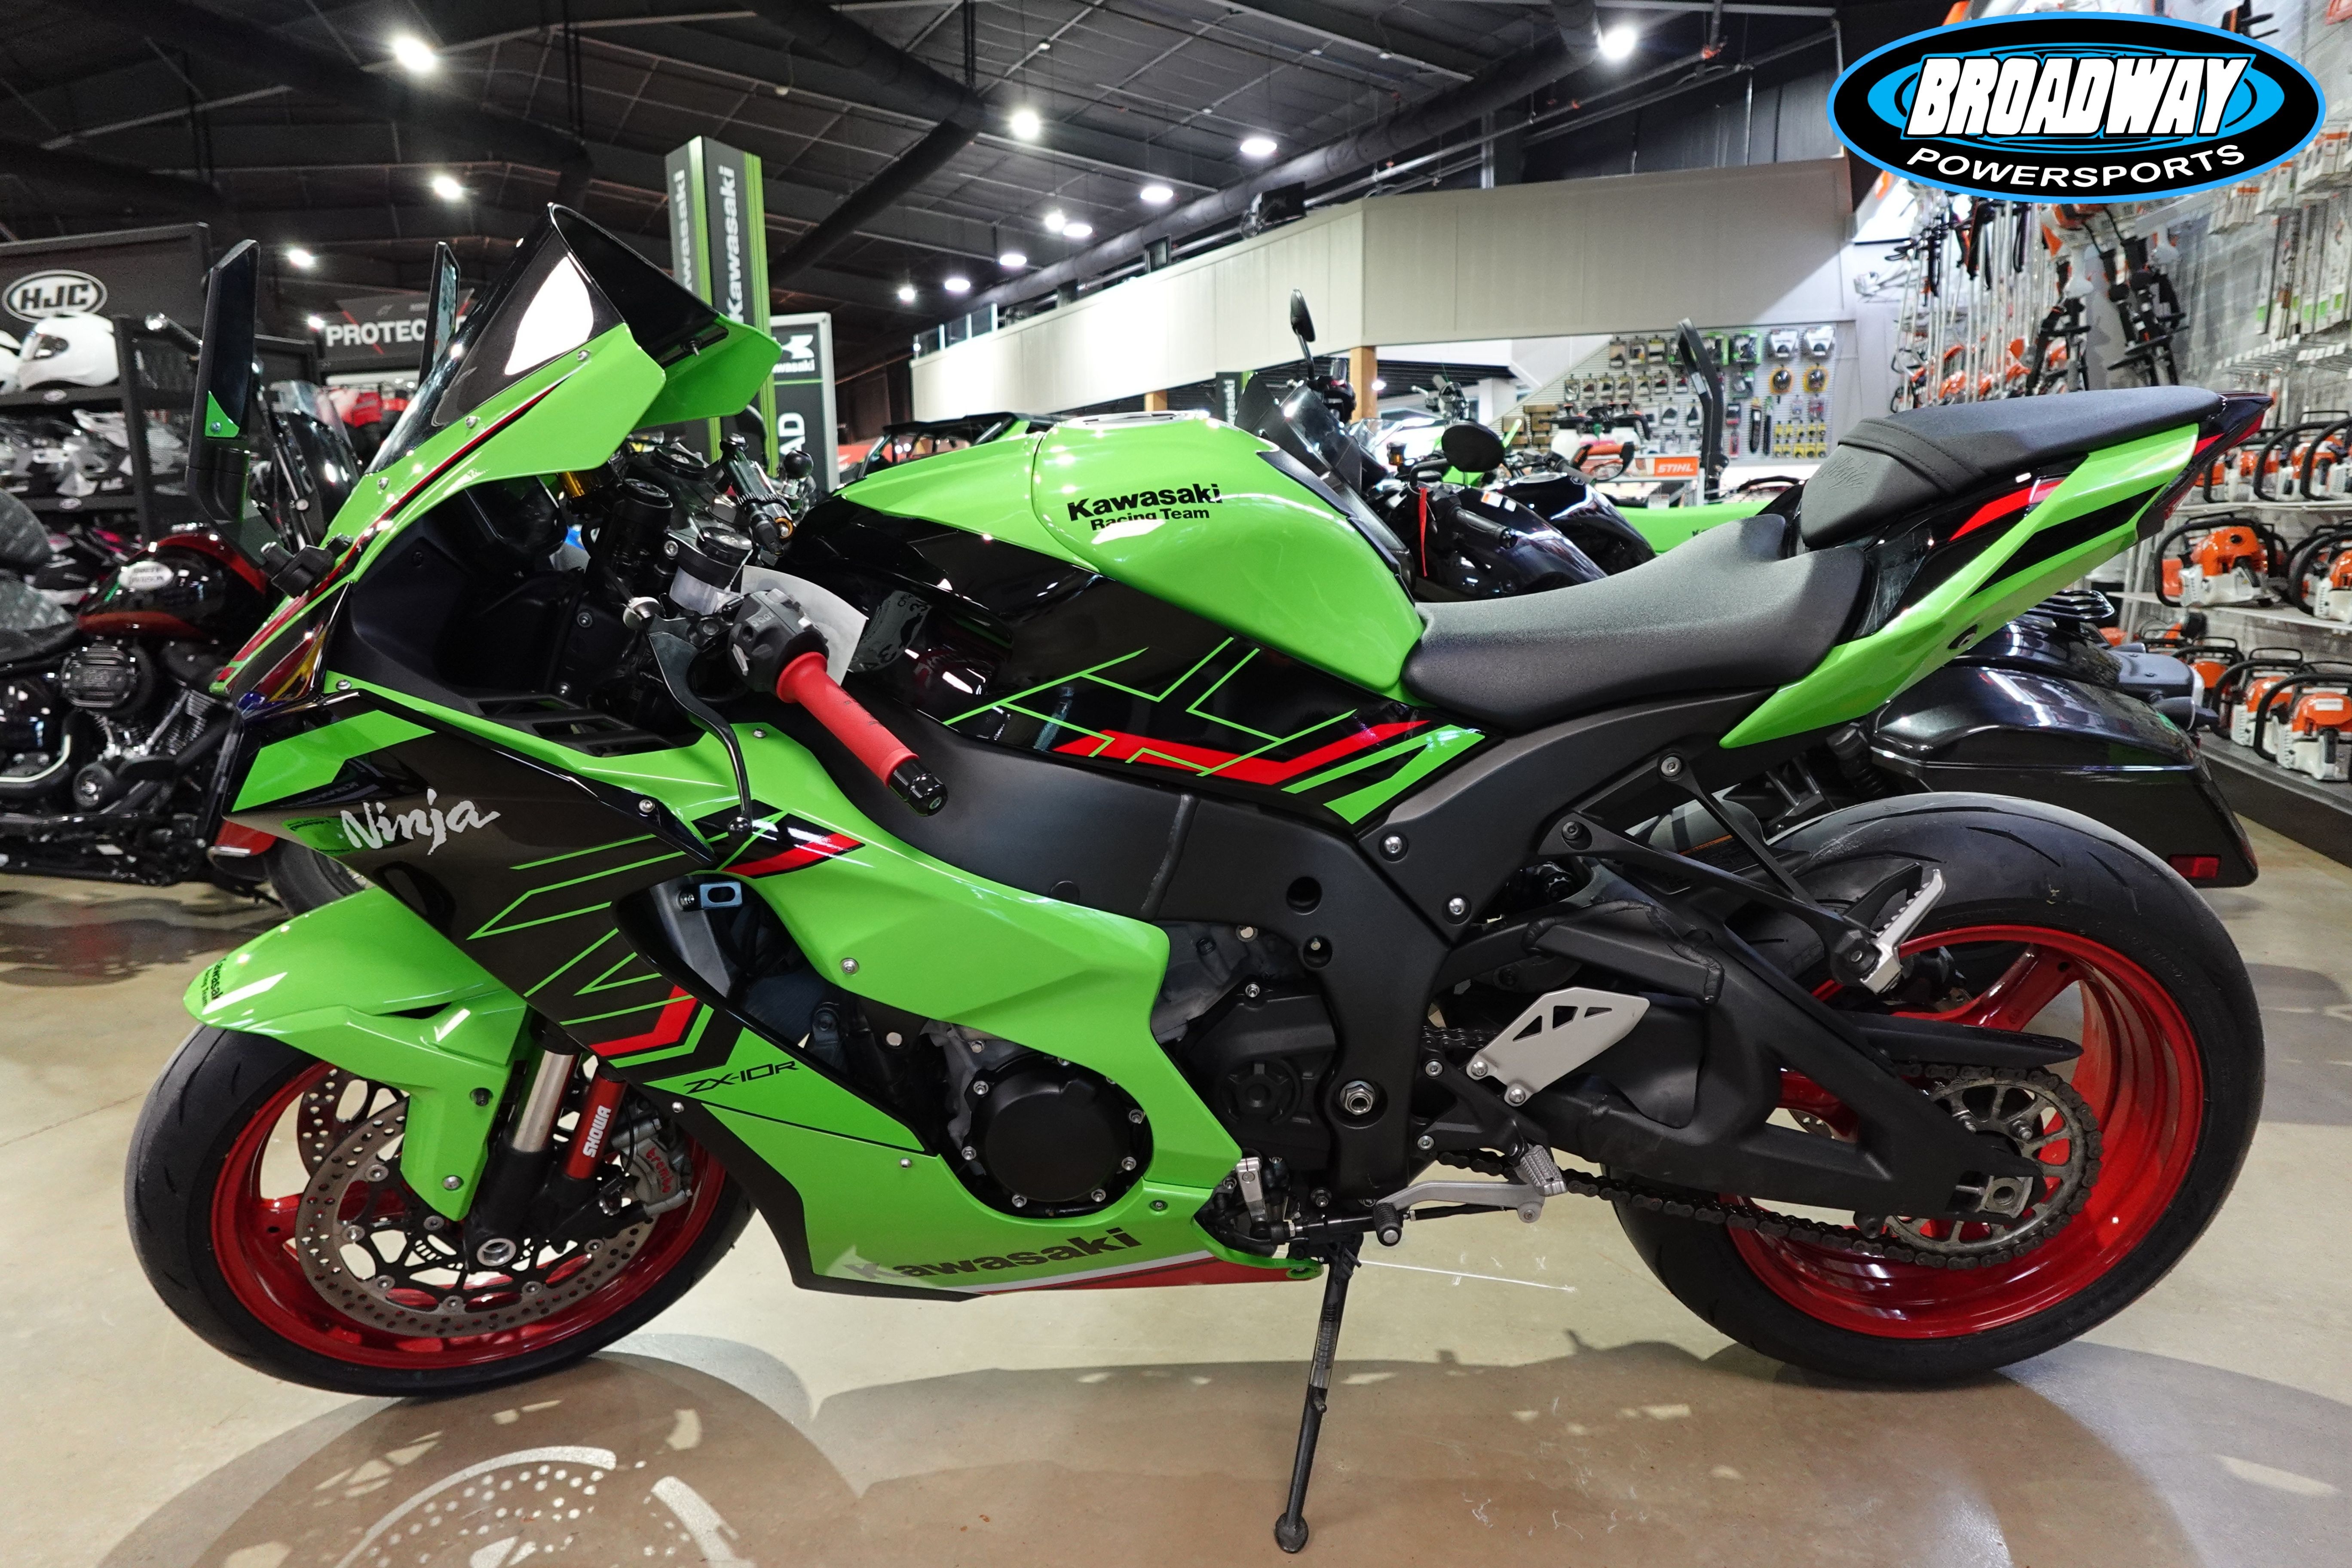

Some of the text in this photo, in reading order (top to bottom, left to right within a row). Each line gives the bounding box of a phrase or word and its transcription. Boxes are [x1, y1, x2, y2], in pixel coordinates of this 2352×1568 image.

[718, 162, 744, 323] Kawasaki
[20, 284, 89, 309] HJC
[1657, 462, 1694, 473] STIHL
[1067, 484, 1222, 521] Kawasaki
[1159, 508, 1210, 520] Team
[340, 787, 501, 855] Ninja
[683, 1061, 799, 1095] ZX-10R
[582, 1105, 612, 1158] SHOWA
[646, 1146, 674, 1193] brembo
[845, 1227, 1142, 1280] Kawasaki
